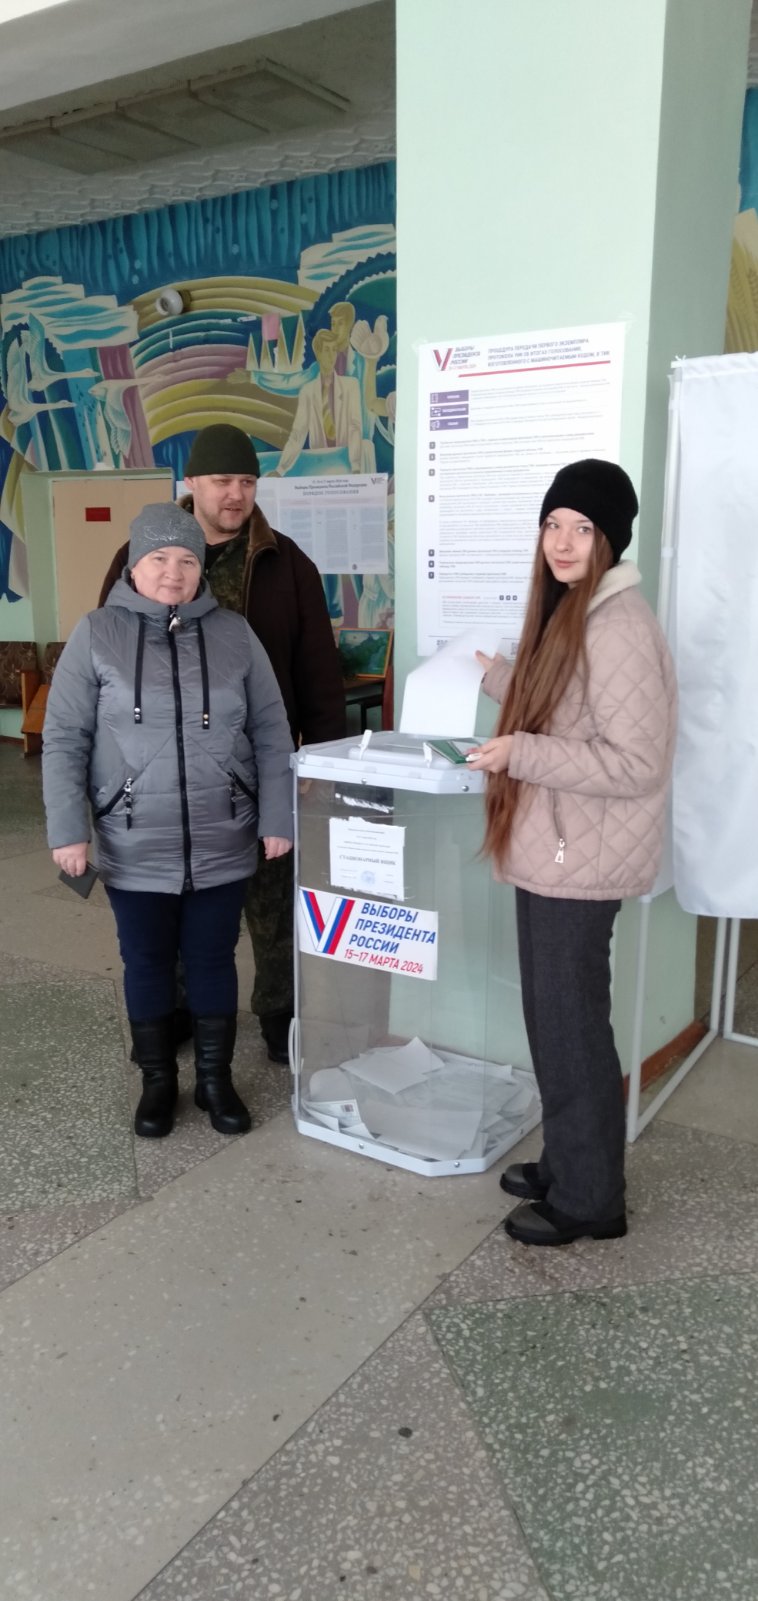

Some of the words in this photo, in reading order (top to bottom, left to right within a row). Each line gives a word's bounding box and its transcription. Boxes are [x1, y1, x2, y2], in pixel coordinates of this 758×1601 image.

[361, 902, 419, 923] ВЫБОРЫ
[354, 918, 437, 945] ПРЕЗИДЕНТА
[349, 934, 400, 954] РОССИИ
[368, 953, 400, 969] МАРТА
[400, 960, 424, 974] 2024
